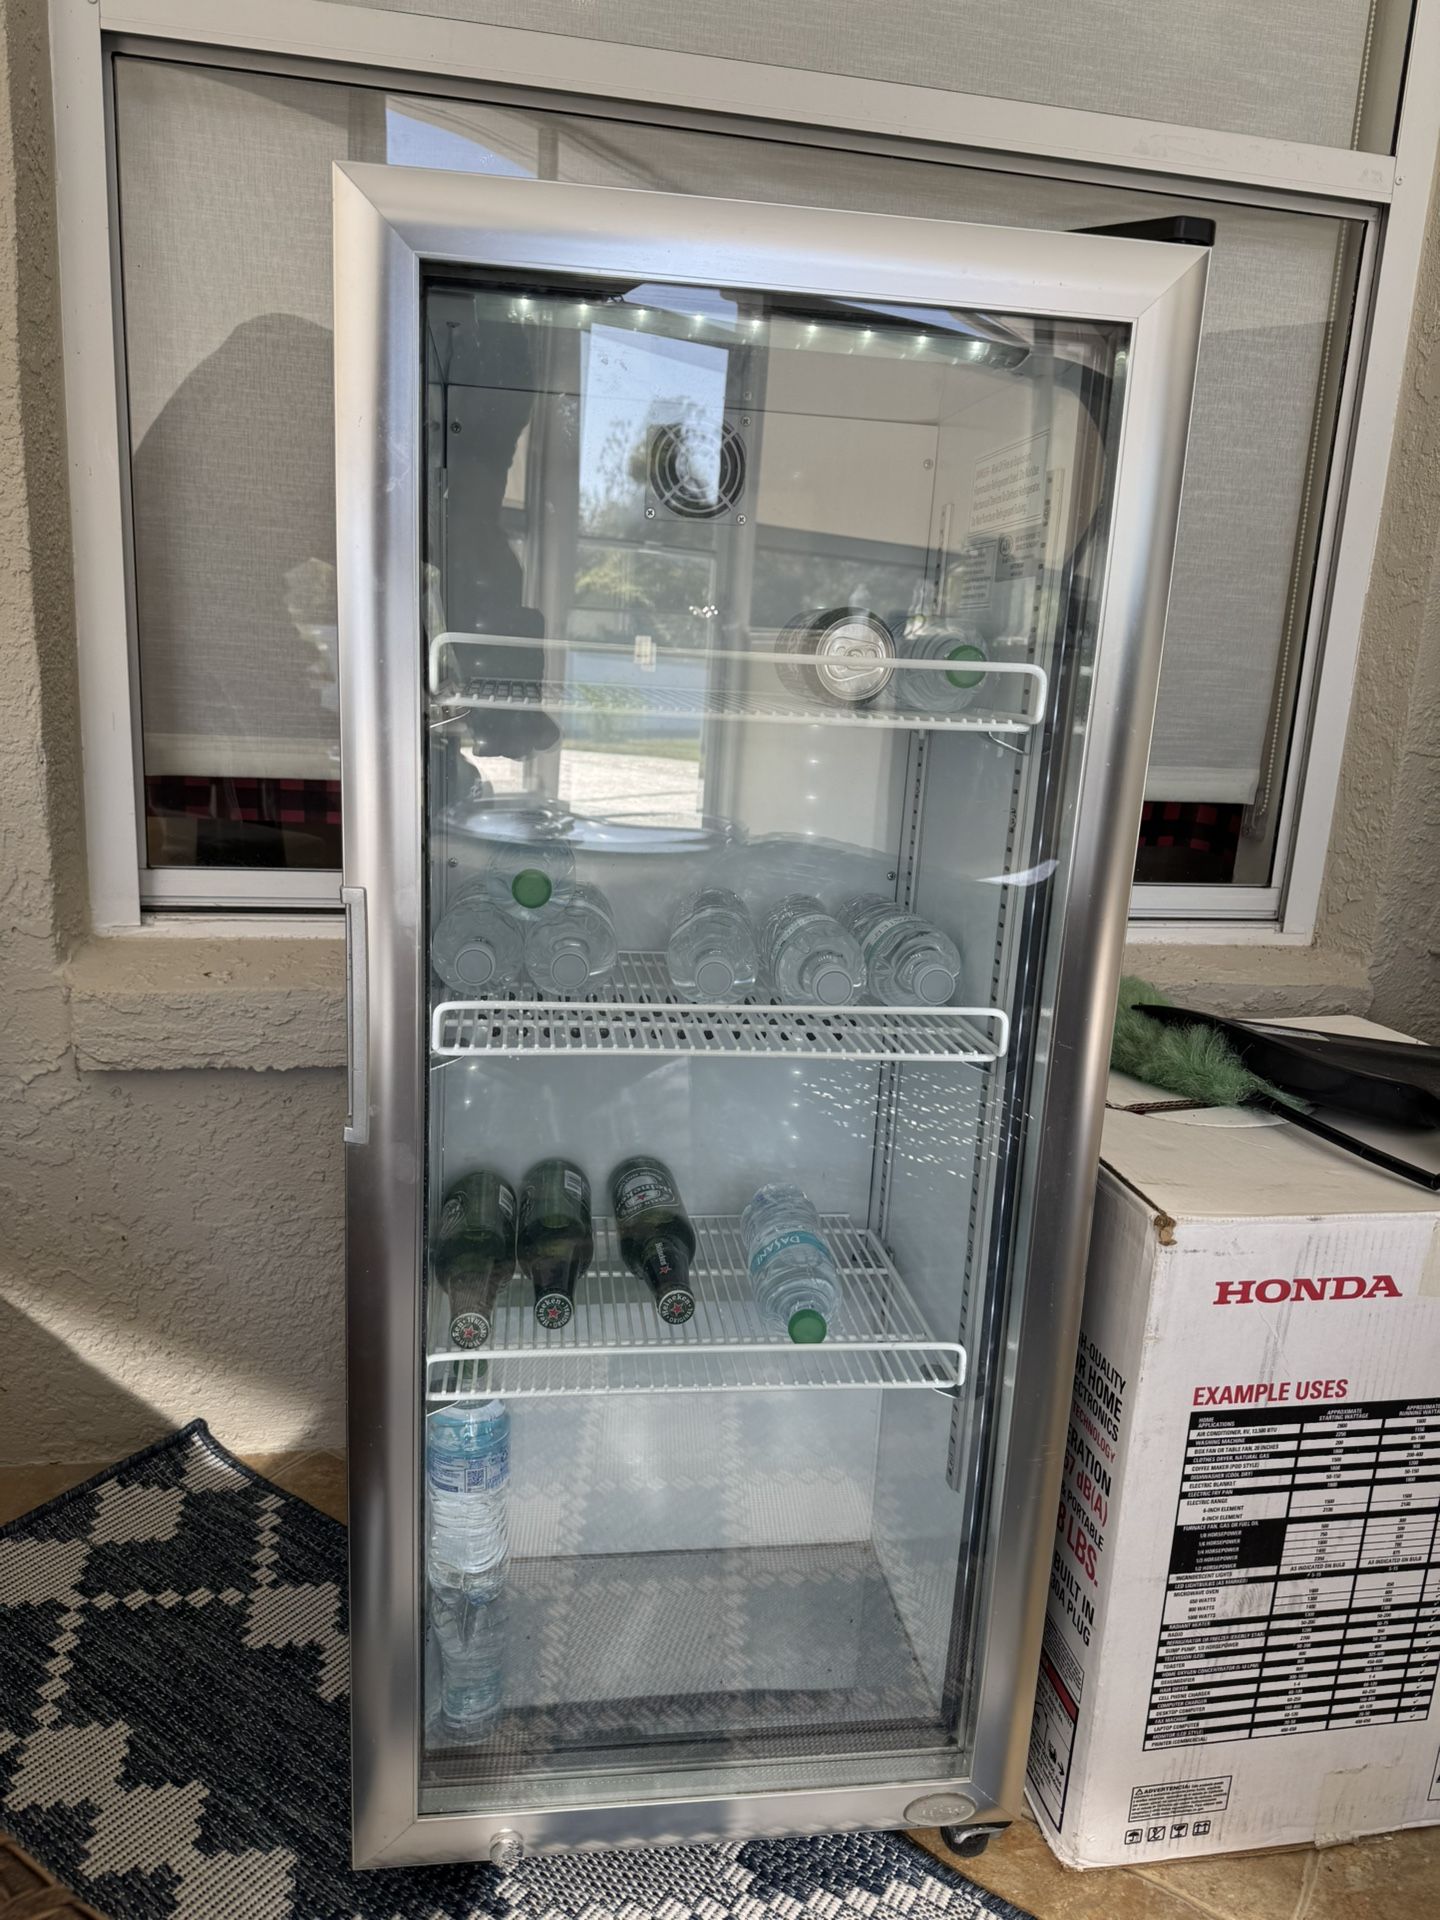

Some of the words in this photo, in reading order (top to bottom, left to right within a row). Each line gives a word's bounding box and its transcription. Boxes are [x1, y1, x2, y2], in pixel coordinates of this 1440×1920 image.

[757, 1235, 801, 1265] DASANI
[1213, 1275, 1402, 1305] HONDA
[1079, 1330, 1126, 1395] H-QUALITY
[1088, 1364, 1123, 1423] HOME
[1193, 1382, 1291, 1406] EXAMPLE
[1295, 1379, 1348, 1400] USES
[1073, 1400, 1115, 1464] TECHNOLOGY
[1197, 1420, 1235, 1428] APPLICATIONS
[1076, 1469, 1108, 1528] dB(A)
[1067, 1489, 1104, 1553] PORTABLE
[1207, 1530, 1242, 1538] HORSEPOWER
[1067, 1514, 1098, 1588] LBS.
[1204, 1546, 1239, 1554] HORSEPOWER
[1206, 1538, 1240, 1546] HORSEPOWER
[1202, 1563, 1236, 1571] HORSEPOWER
[1203, 1554, 1238, 1562] HORSEPOWER
[1053, 1549, 1081, 1603] BUILT
[1082, 1594, 1095, 1627] IN
[1175, 1572, 1214, 1581] INCANDESCENT
[1067, 1598, 1091, 1648] PLUG
[1205, 1641, 1239, 1649] HORSEPOWER
